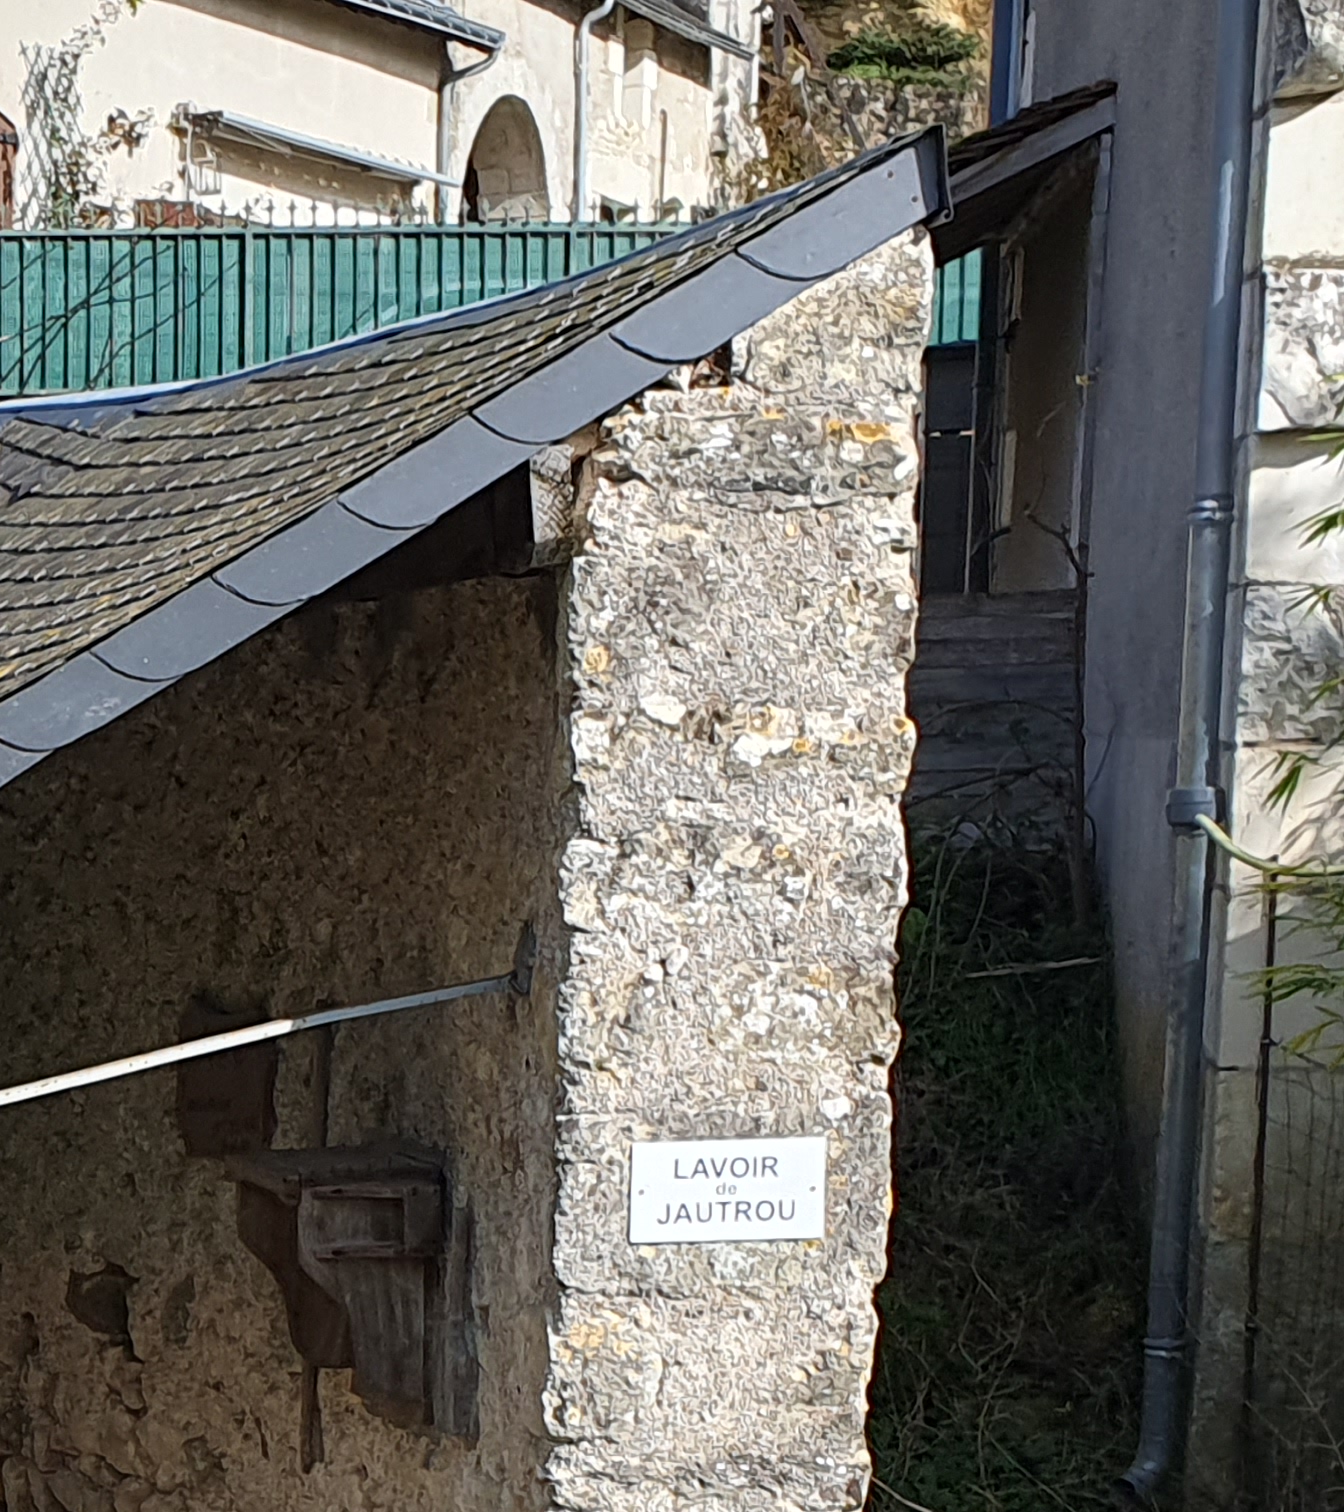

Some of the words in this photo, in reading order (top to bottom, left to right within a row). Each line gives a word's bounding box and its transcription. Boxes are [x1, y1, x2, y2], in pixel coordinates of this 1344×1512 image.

[674, 1156, 779, 1179] LAVOIR
[715, 1182, 737, 1195] de
[657, 1199, 796, 1225] JAUTROU
